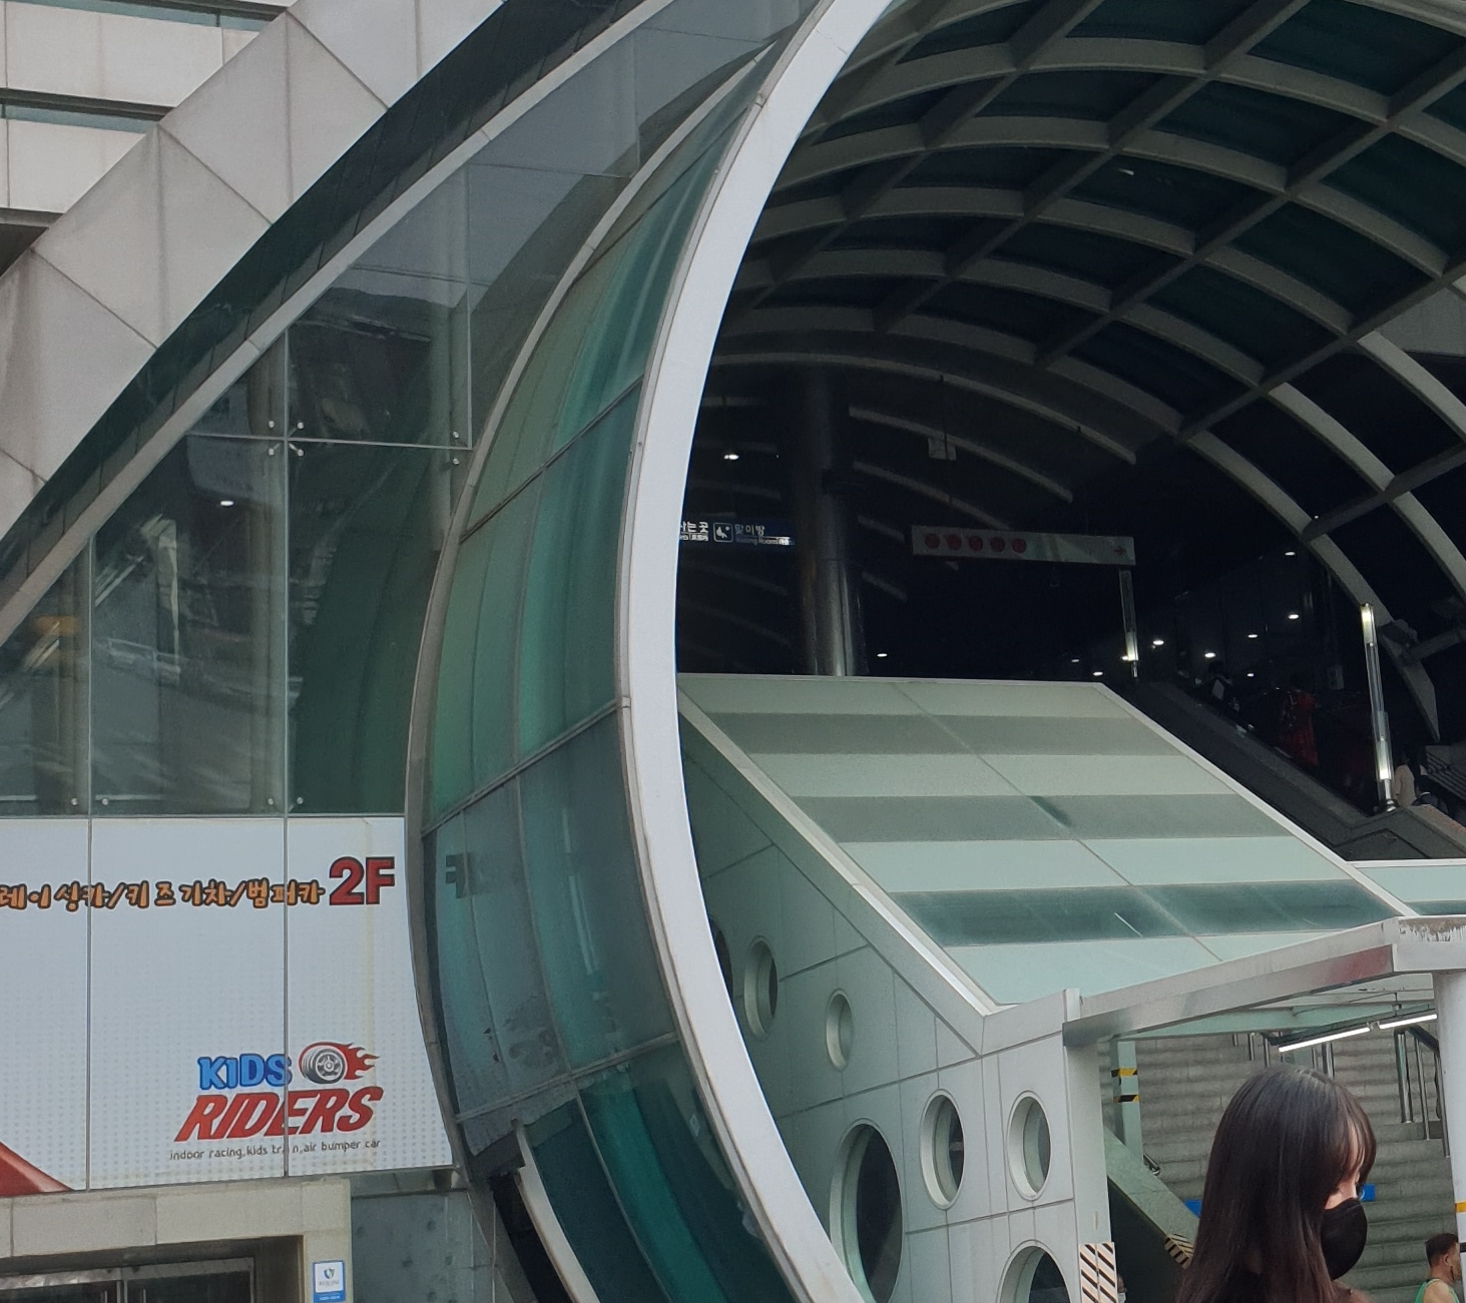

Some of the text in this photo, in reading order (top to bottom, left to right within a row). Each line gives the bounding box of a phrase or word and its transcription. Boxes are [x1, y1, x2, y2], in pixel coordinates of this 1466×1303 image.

[329, 855, 396, 906] 2F
[197, 1053, 293, 1090] KIDS
[174, 1086, 384, 1142] RIDERS
[170, 1149, 204, 1161] indoor
[321, 1140, 362, 1153] bumper
[365, 1139, 381, 1149] car
